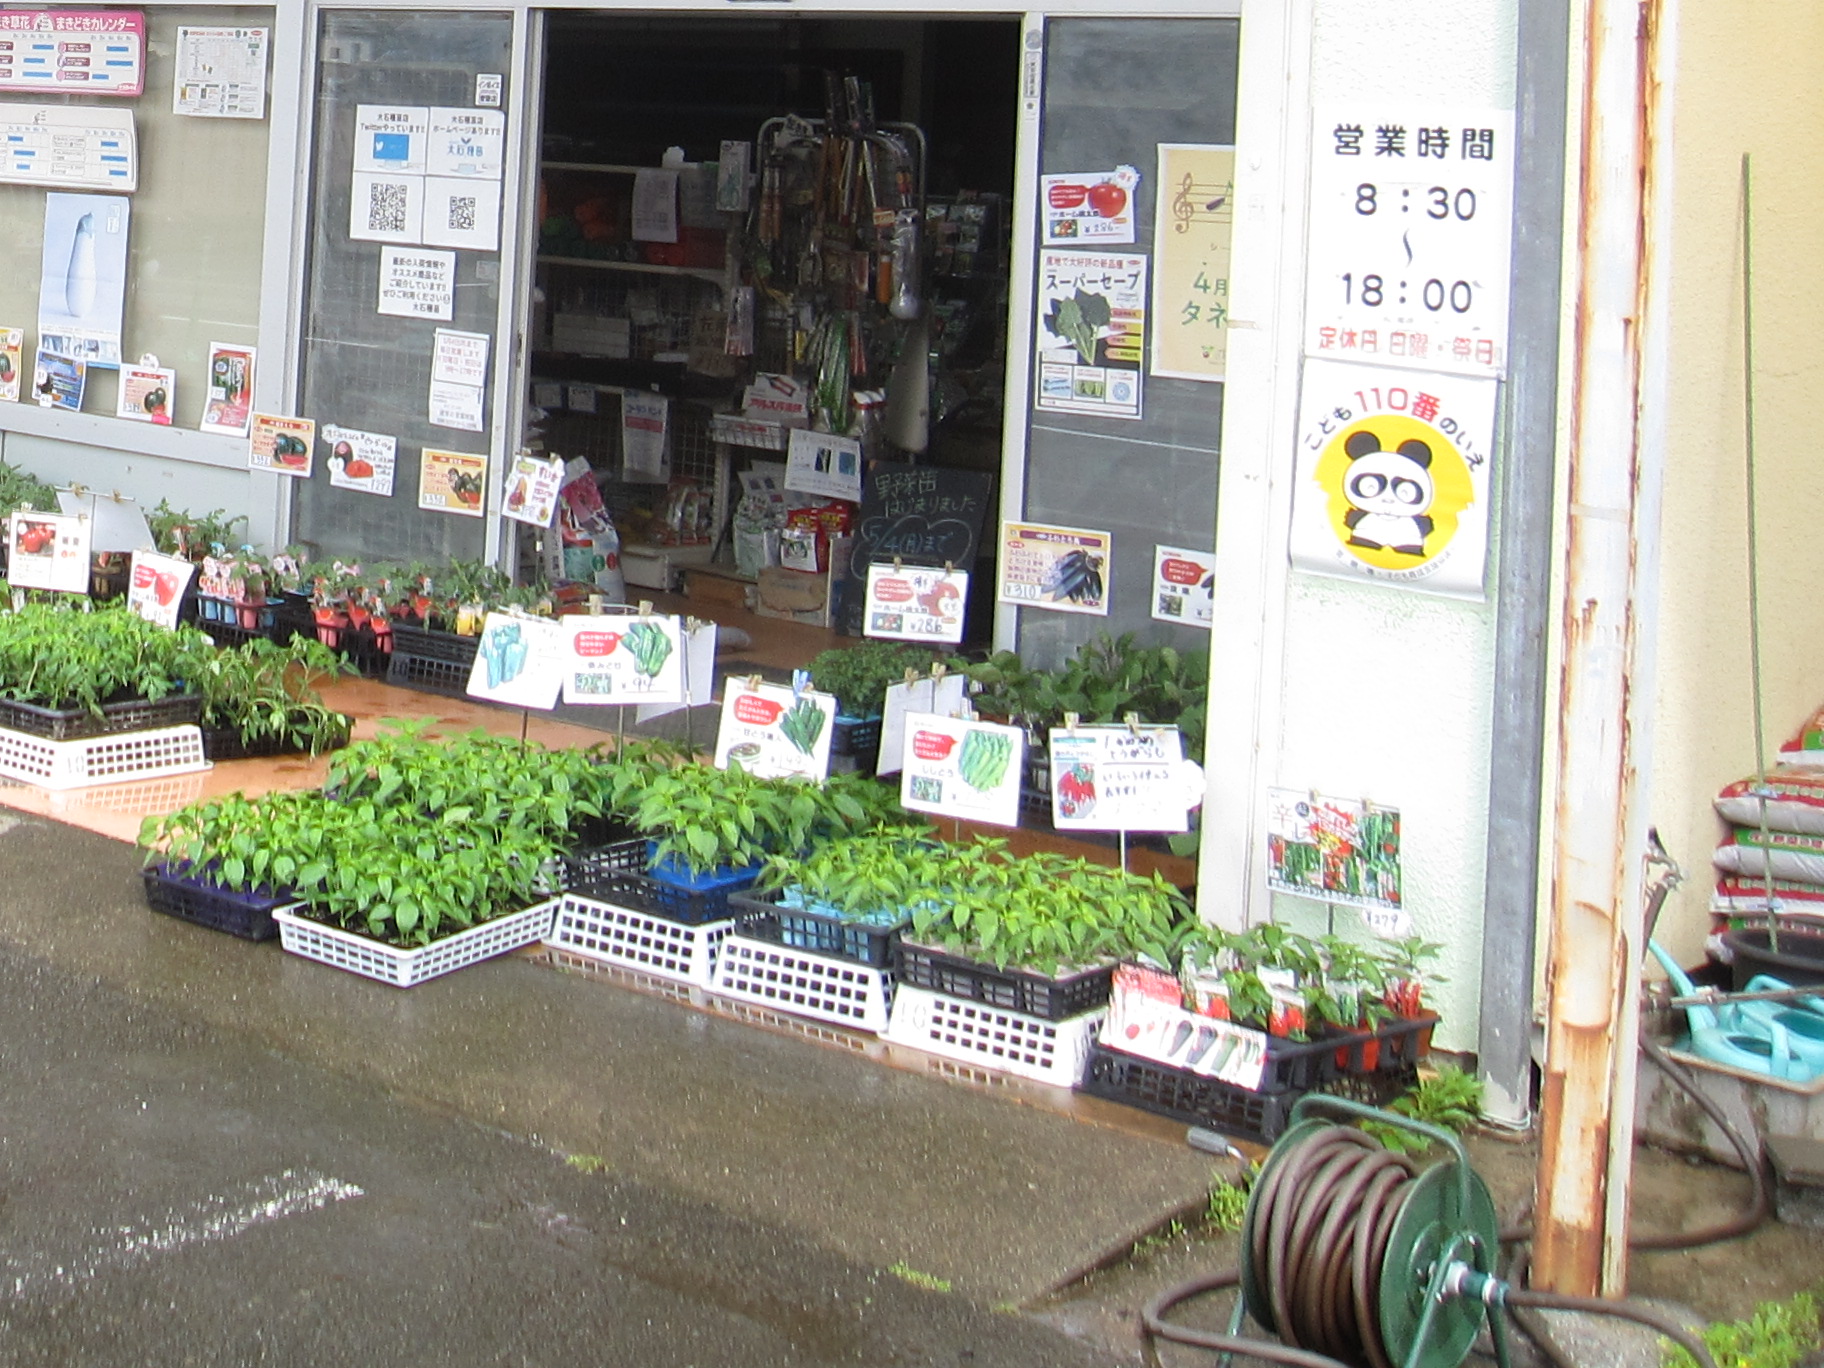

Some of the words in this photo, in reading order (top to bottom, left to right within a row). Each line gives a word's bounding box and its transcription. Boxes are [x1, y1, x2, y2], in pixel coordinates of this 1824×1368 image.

[56, 16, 136, 32] まきどきカレンダー
[376, 113, 409, 123] 大石種苗店
[451, 116, 484, 125] 大石種苗店
[1332, 123, 1496, 162] 営業時間
[1354, 182, 1477, 222] 8:30
[1341, 272, 1473, 314] 18:00
[1318, 326, 1379, 354] 定休日
[1305, 387, 1485, 472] こども110番のいえ
